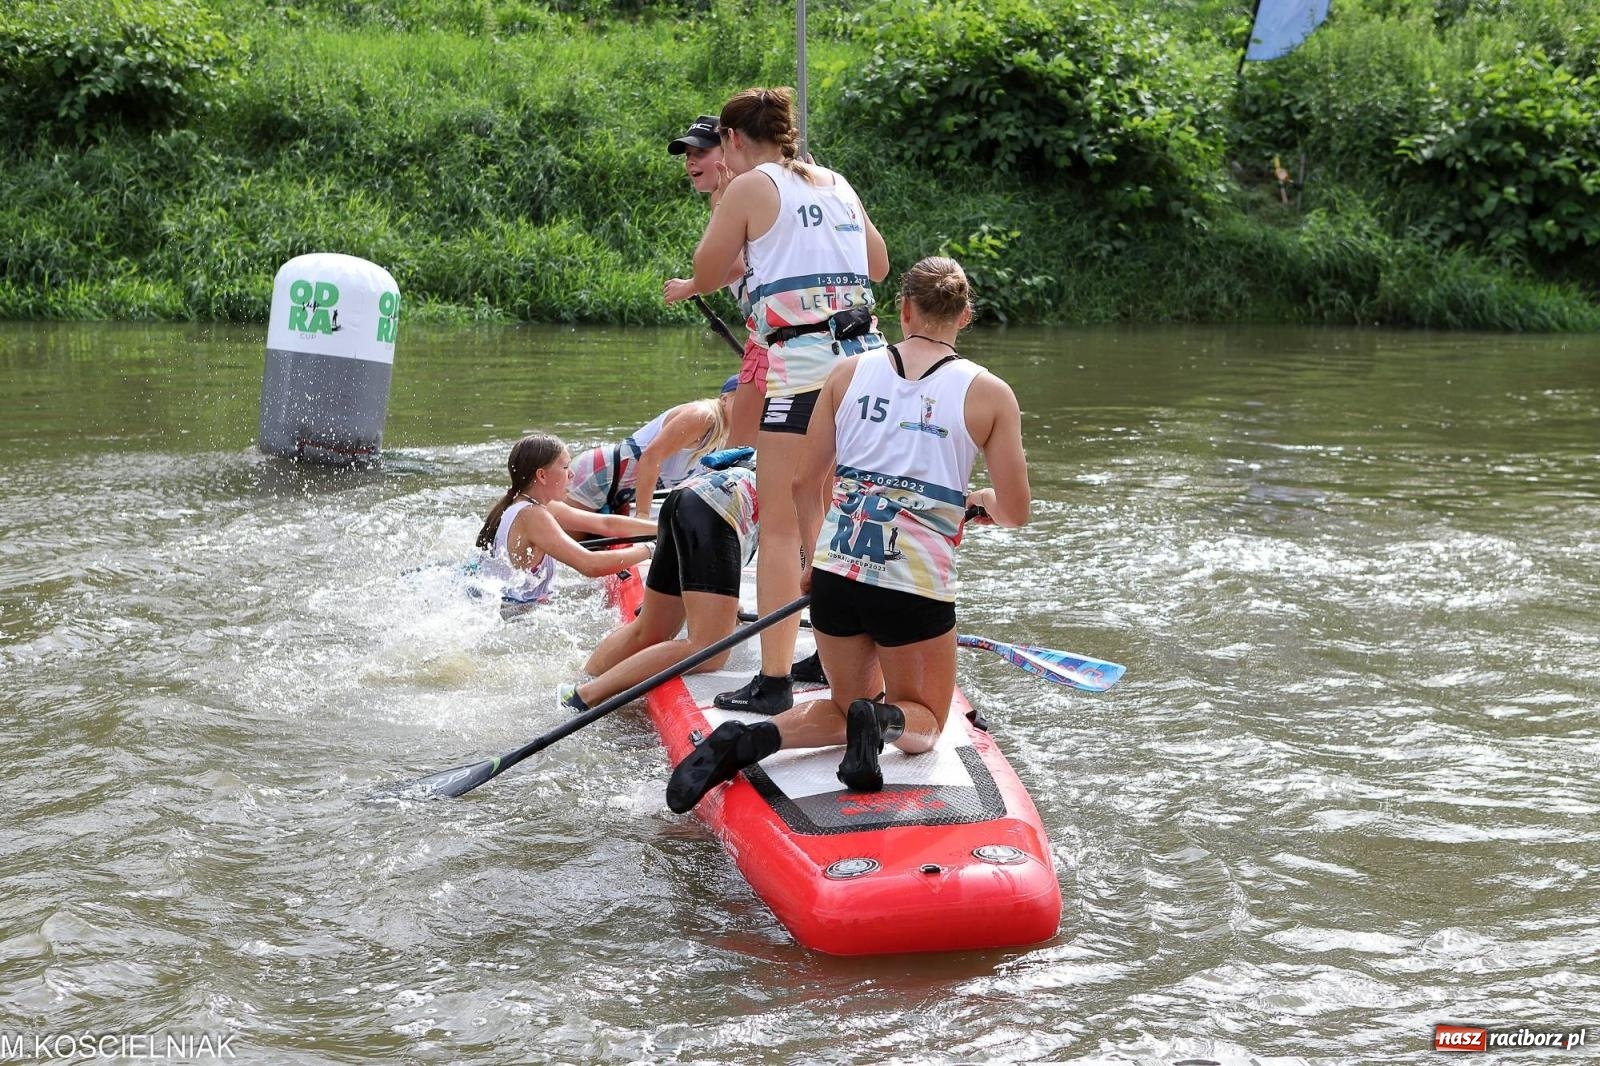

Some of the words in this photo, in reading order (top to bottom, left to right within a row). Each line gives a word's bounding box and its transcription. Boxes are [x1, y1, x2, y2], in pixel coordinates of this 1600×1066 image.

[797, 204, 823, 228] 19
[290, 280, 340, 308] OD
[288, 306, 333, 335] RA
[857, 394, 890, 423] 15
[829, 515, 886, 565] RA
